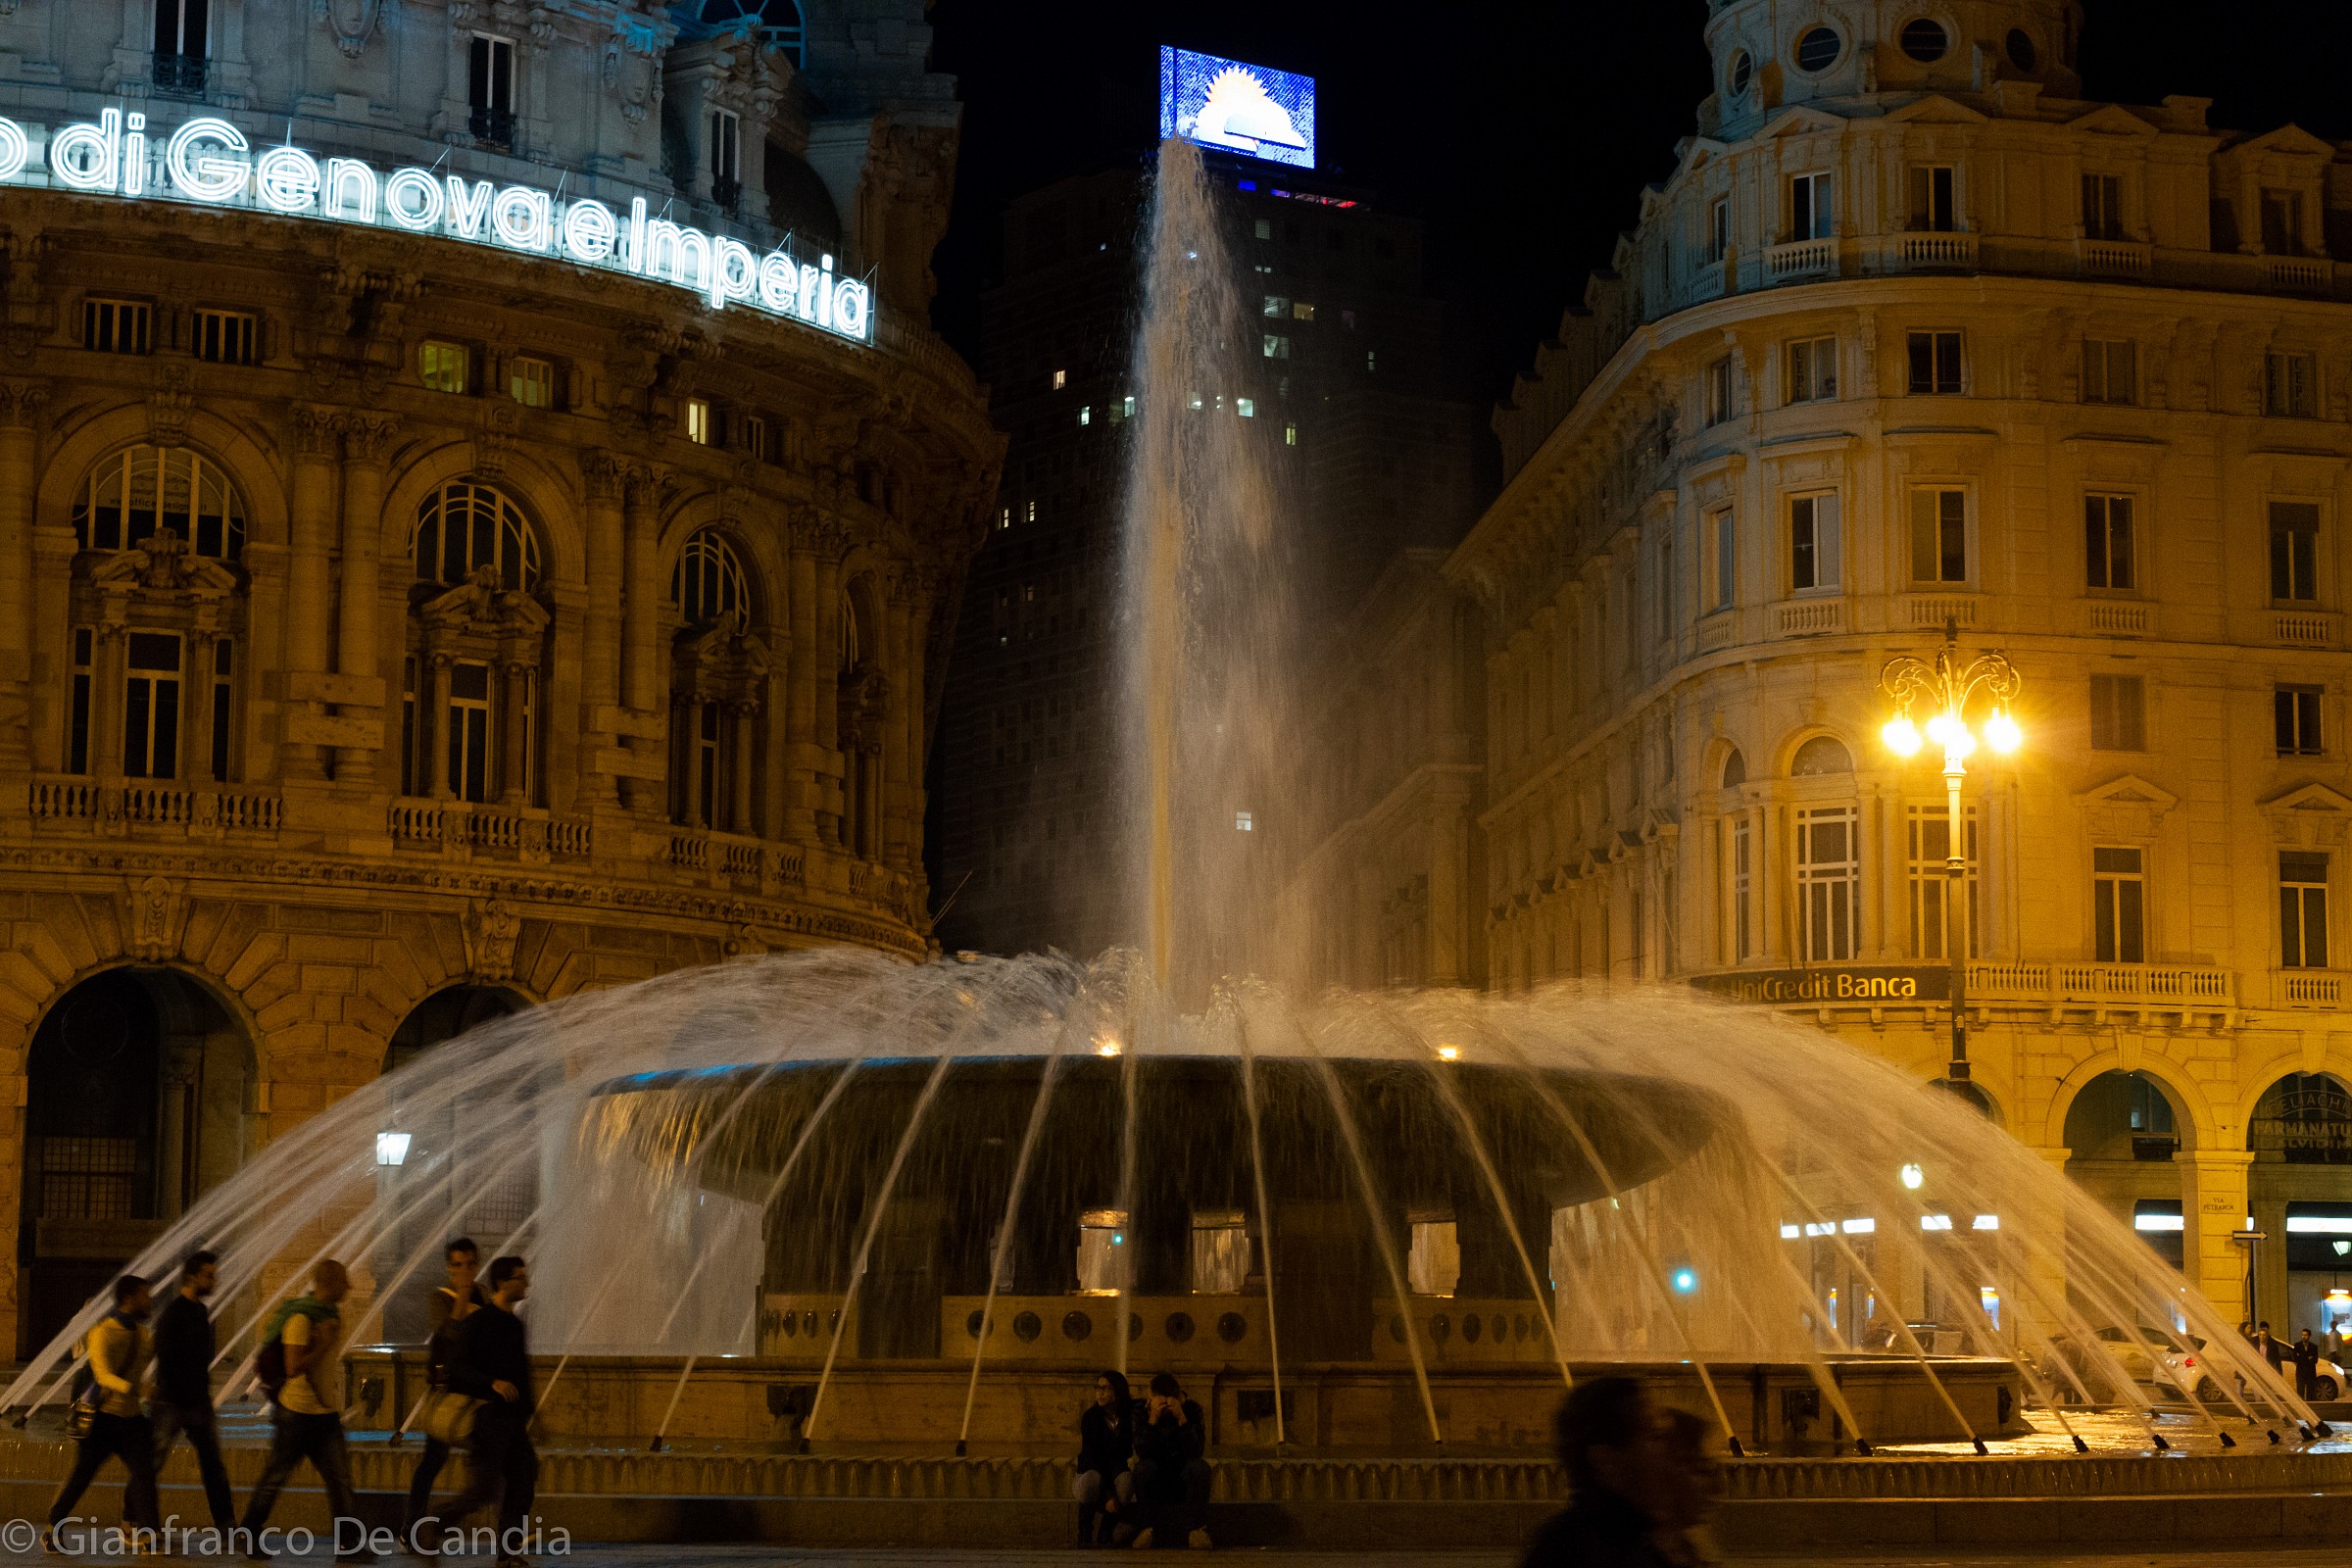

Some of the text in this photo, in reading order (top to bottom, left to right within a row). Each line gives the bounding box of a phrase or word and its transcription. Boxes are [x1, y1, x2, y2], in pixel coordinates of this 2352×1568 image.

[50, 107, 146, 196] di
[167, 117, 551, 253] Genova
[564, 199, 615, 262] e
[627, 196, 870, 340] Imperia
[1731, 972, 1916, 1003] UniCredit Banca
